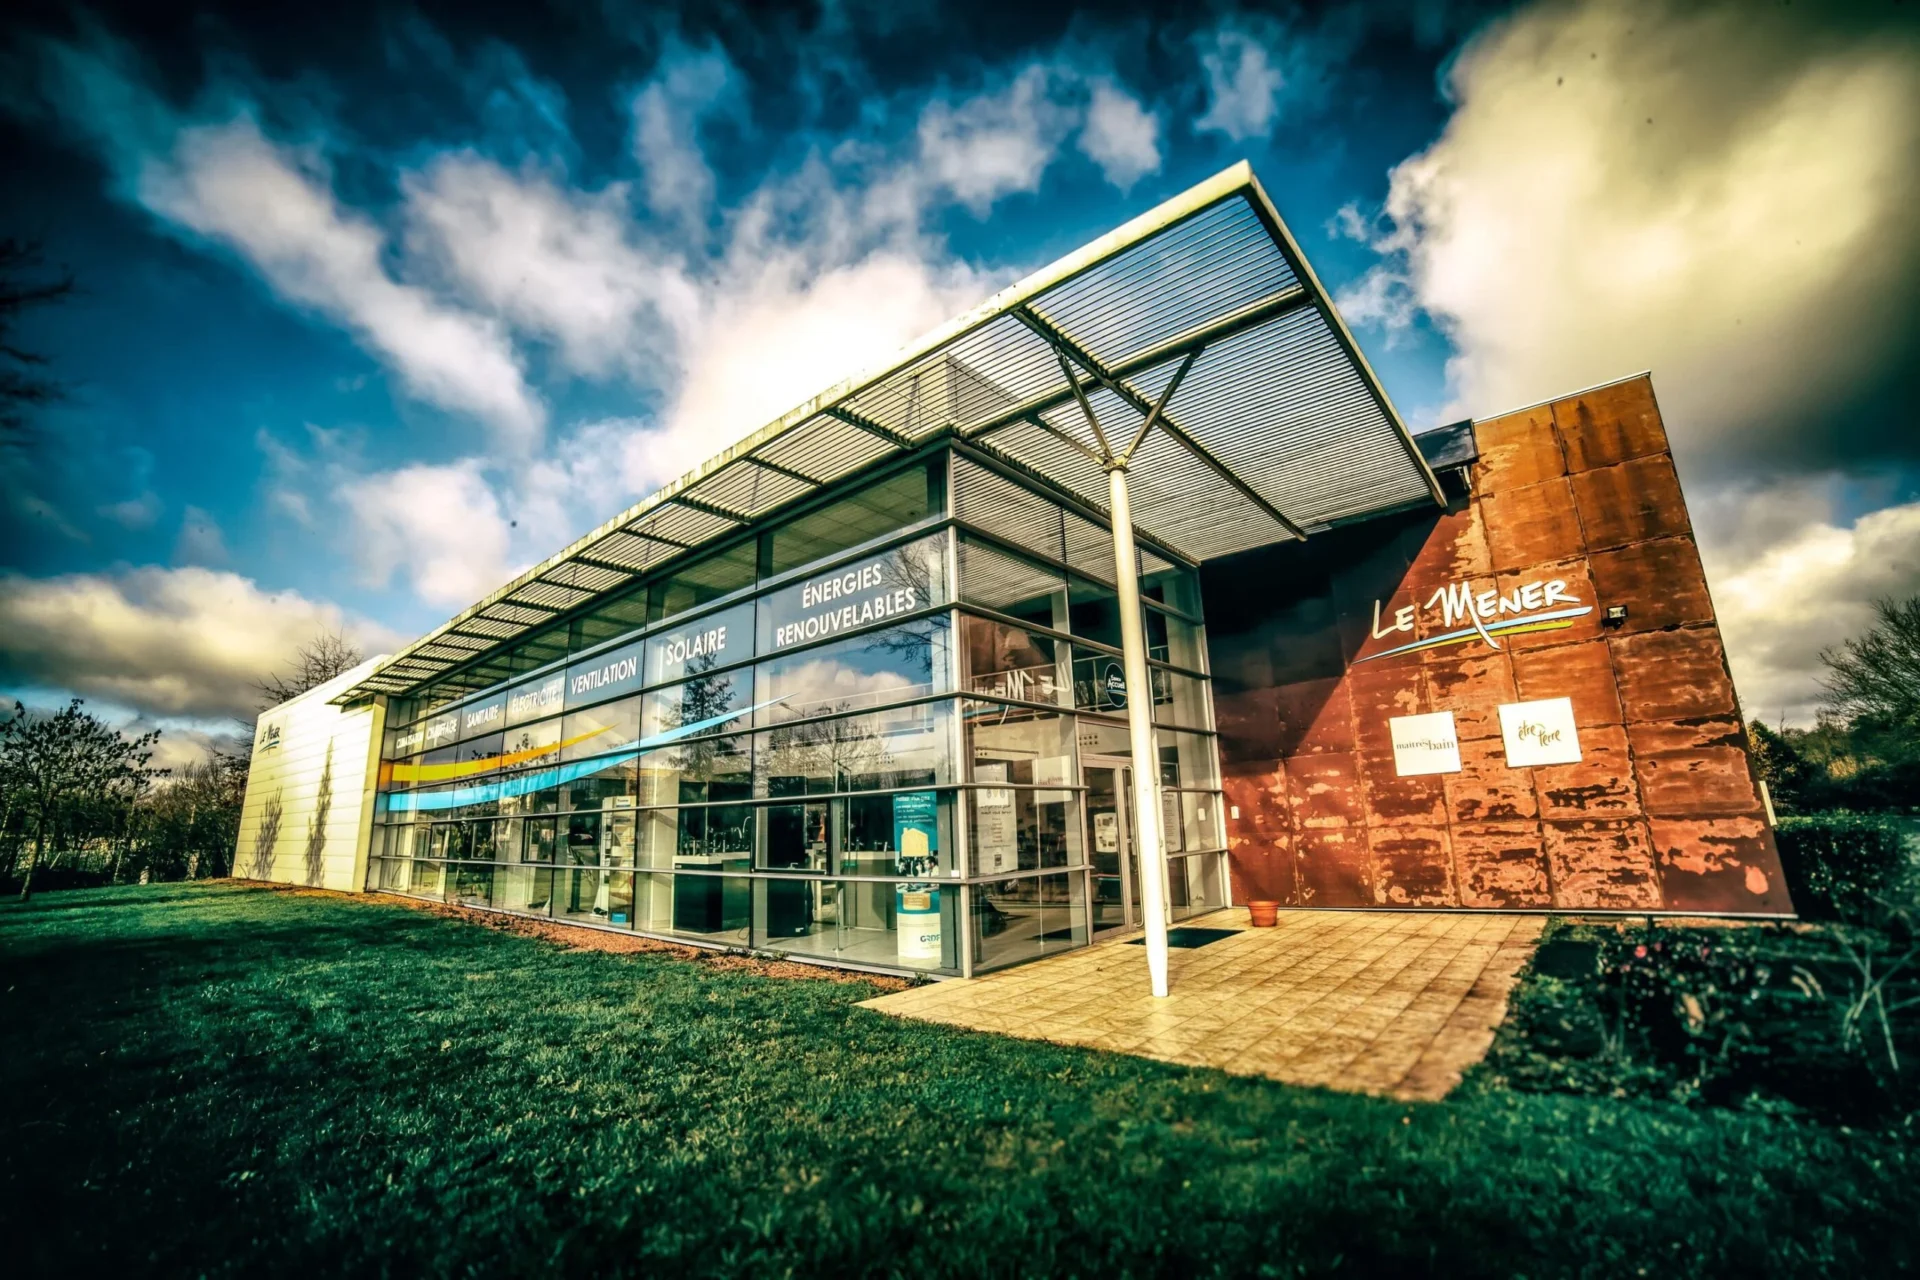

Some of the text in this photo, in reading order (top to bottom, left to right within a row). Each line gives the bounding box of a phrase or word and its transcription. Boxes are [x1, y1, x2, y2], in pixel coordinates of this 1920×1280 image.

[802, 563, 882, 609] ÉNERGIES
[777, 587, 916, 647] RENOUVELABLES
[1371, 579, 1581, 650] LE MENER
[666, 626, 727, 666] SOLAIRE
[571, 656, 638, 695] VENTILATION
[466, 704, 499, 729] SANITAIRE
